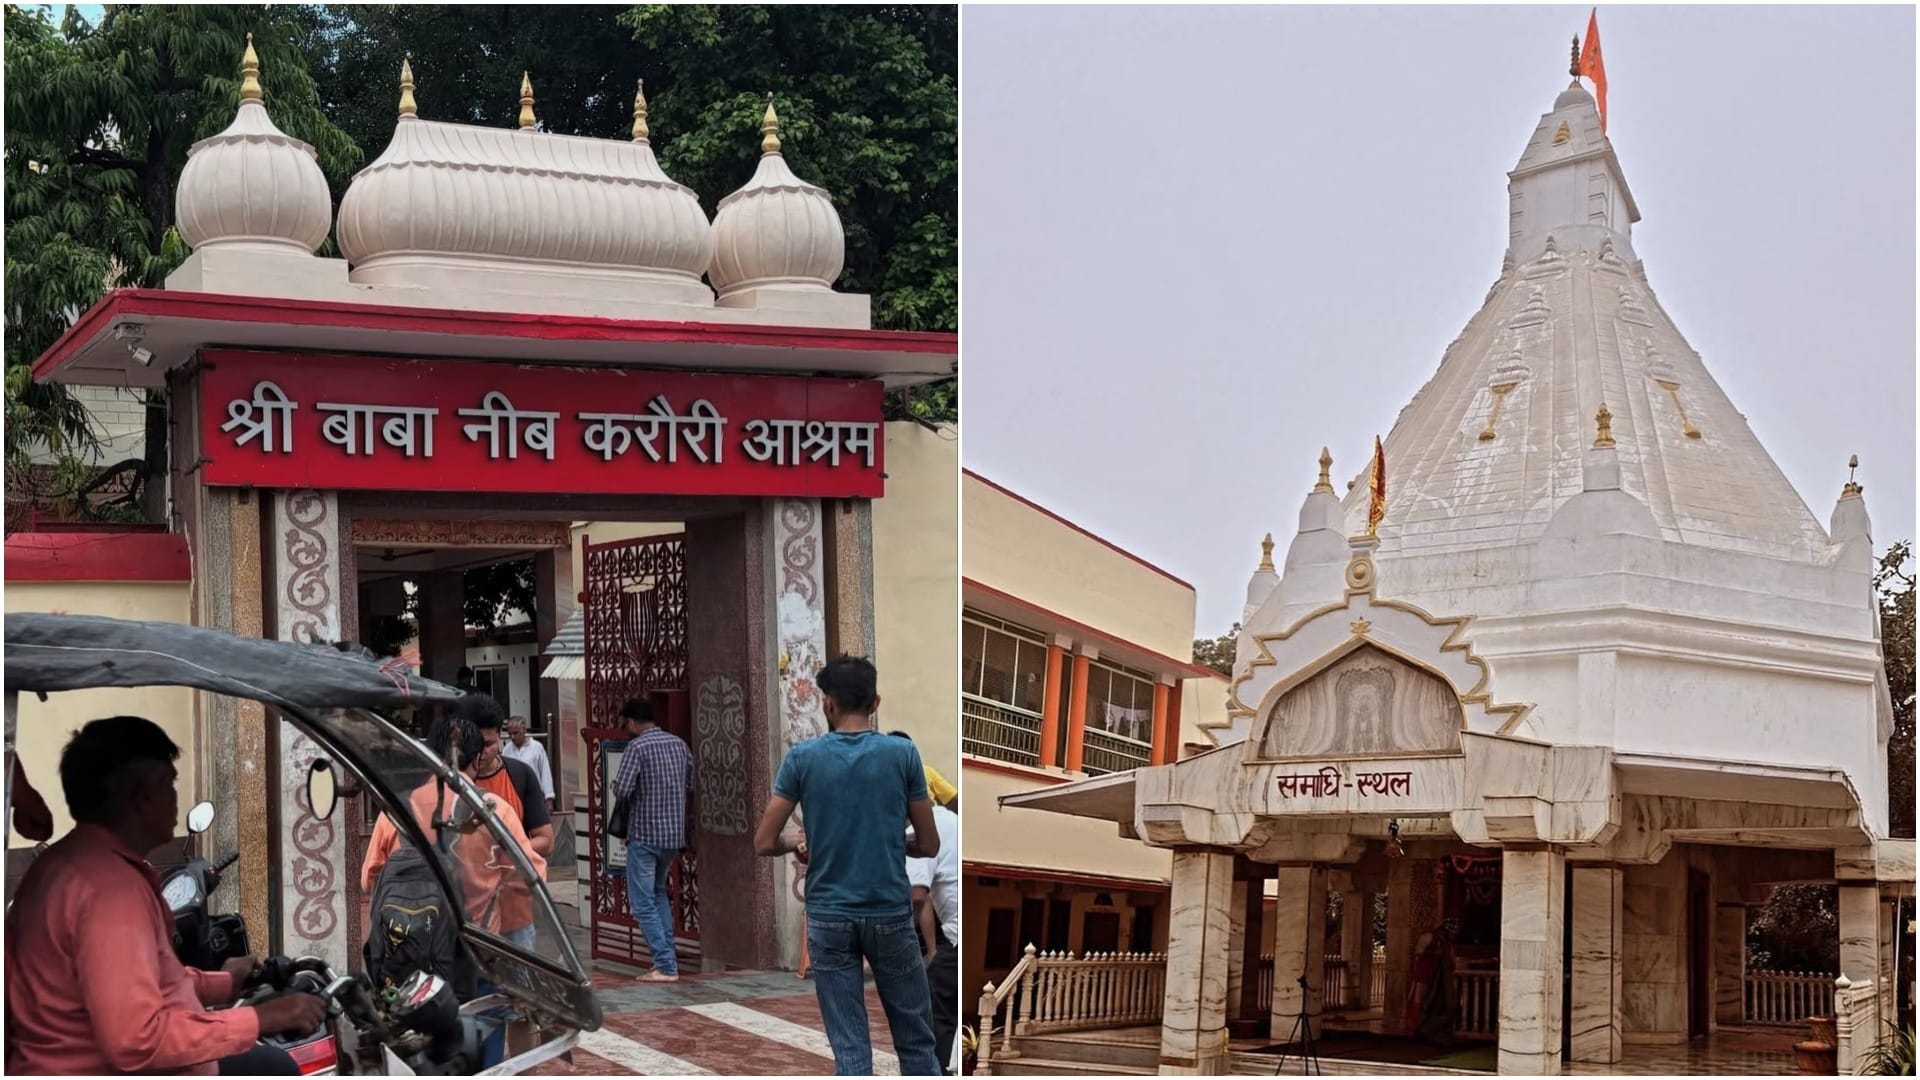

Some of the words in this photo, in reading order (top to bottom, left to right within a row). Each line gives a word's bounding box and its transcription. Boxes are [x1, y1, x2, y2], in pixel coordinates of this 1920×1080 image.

[220, 381, 299, 453] श्री
[316, 402, 440, 458] बाबा
[458, 391, 561, 460] नीब
[578, 394, 728, 464] करौरी
[742, 418, 880, 467] आश्रम
